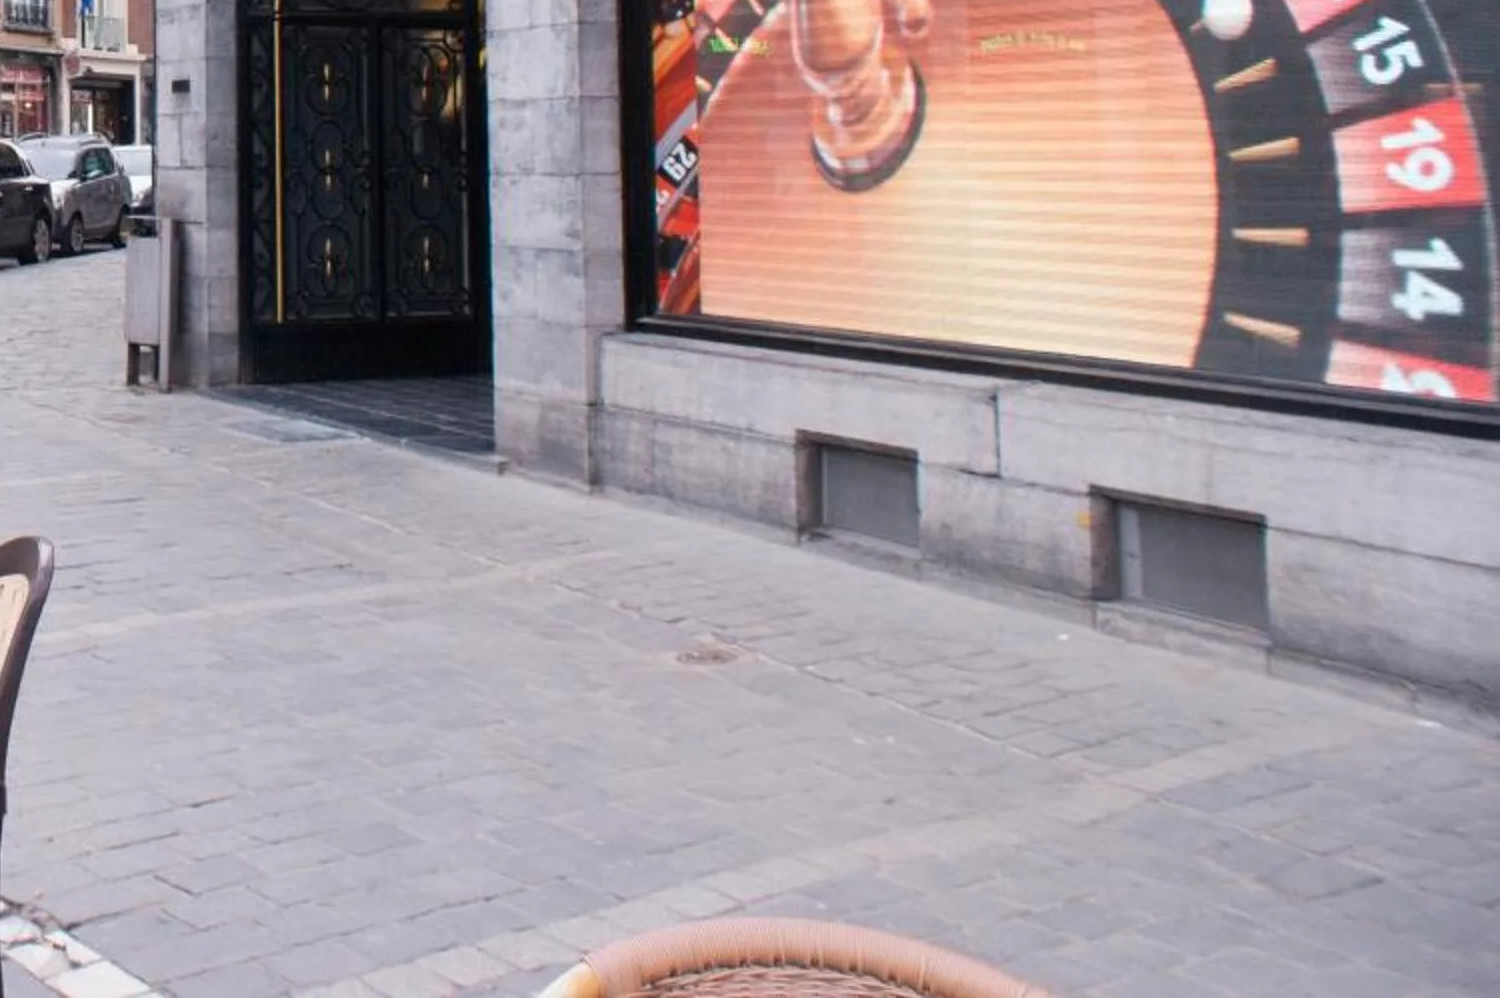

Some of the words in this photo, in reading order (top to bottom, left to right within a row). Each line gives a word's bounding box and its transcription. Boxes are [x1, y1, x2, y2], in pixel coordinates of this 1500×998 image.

[1352, 16, 1425, 85] 15
[1380, 116, 1455, 192] 19
[1391, 237, 1464, 320] 14
